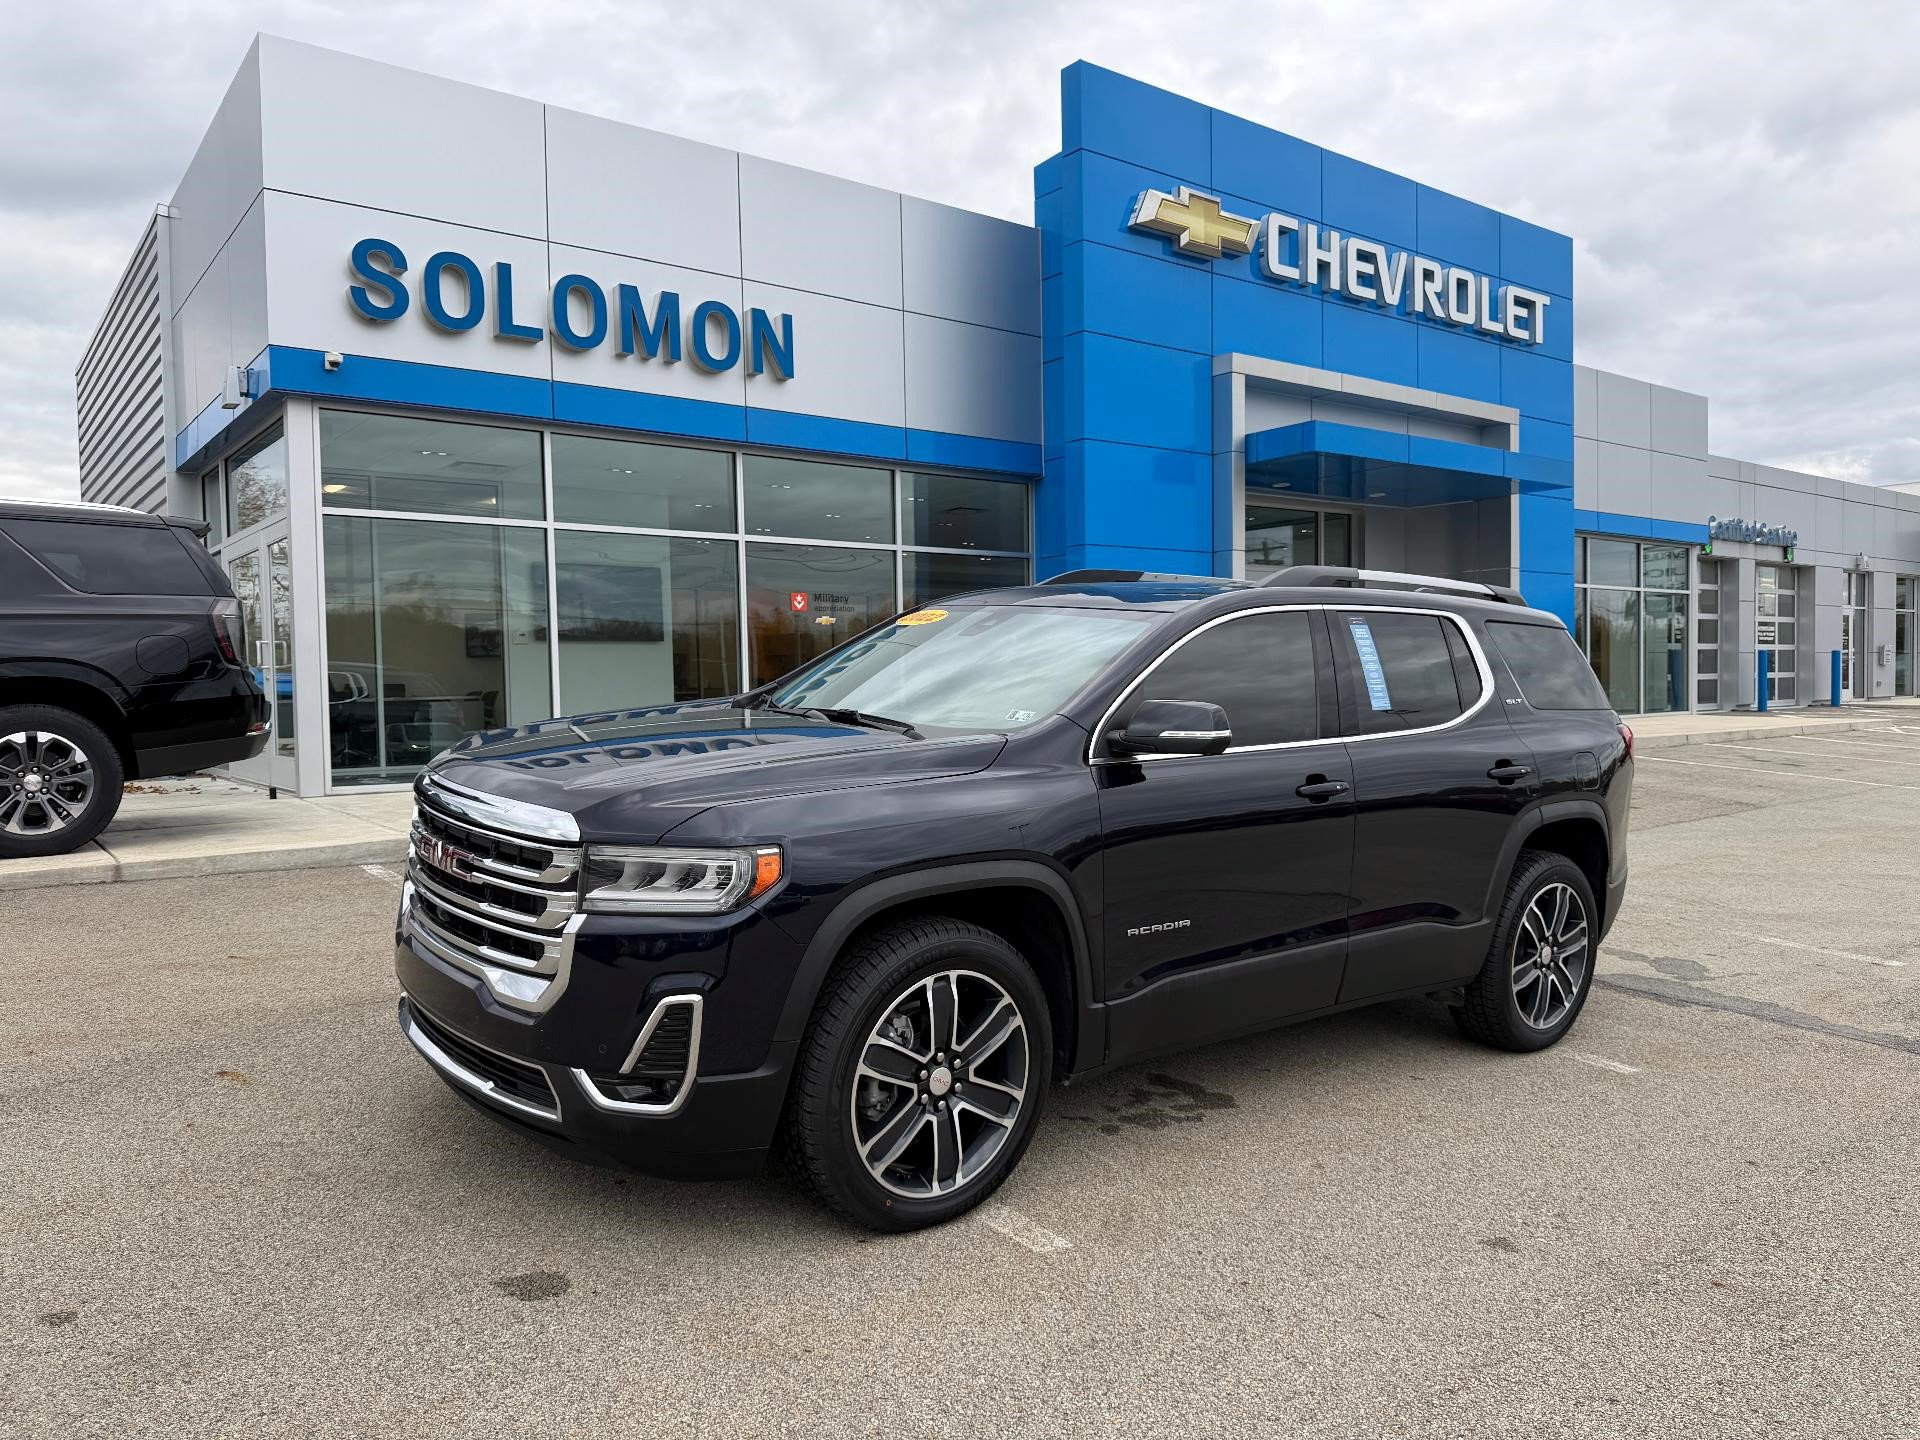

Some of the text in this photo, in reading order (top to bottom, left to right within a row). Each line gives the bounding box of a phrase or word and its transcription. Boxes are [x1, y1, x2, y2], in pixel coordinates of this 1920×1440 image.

[1260, 212, 1551, 345] CHEVROLET
[346, 238, 795, 381] SOLOMON
[1708, 515, 1798, 548] Certified Service
[814, 593, 849, 605] Military
[419, 832, 475, 883] GMC
[1127, 919, 1191, 937] ACADIA
[932, 1075, 950, 1087] GMC
